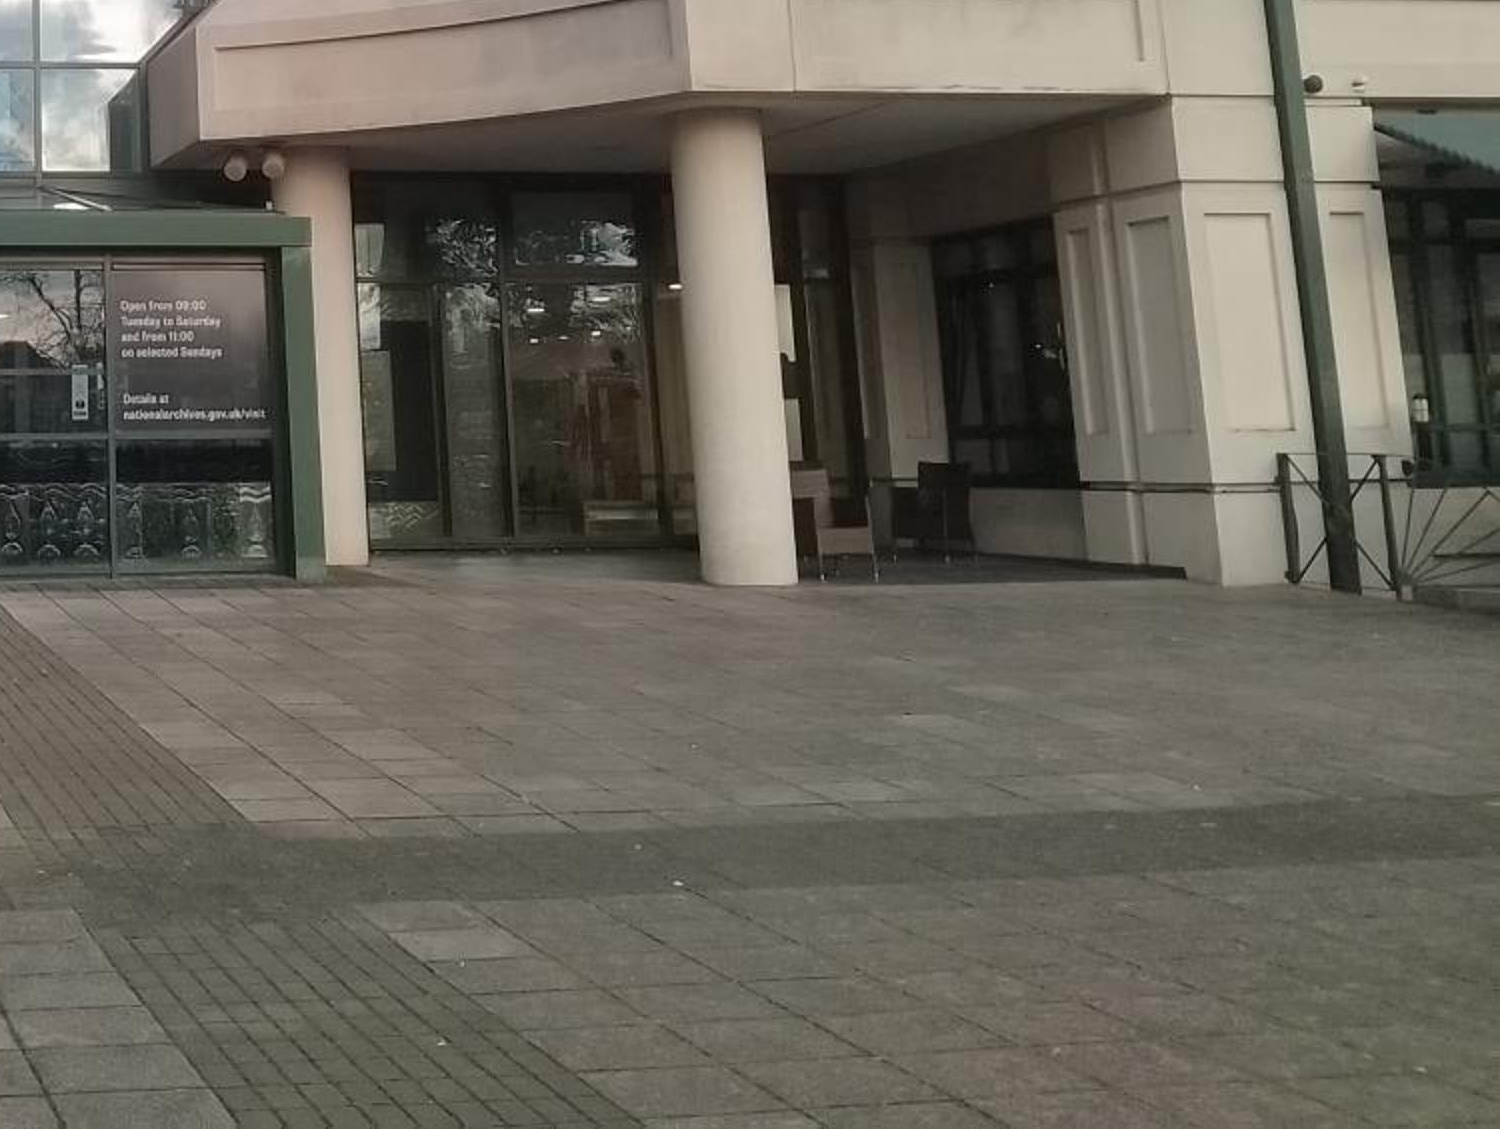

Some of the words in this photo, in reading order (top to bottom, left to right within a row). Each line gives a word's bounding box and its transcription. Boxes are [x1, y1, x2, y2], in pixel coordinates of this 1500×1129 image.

[120, 300, 147, 312] Open
[149, 300, 173, 311] from
[121, 316, 161, 328] Tuesday
[163, 317, 174, 327] to
[176, 316, 221, 329] Saturday
[121, 331, 140, 342] and
[142, 331, 167, 342] from
[169, 331, 194, 342] 11:00
[121, 348, 134, 358] on
[136, 346, 178, 358] selected
[180, 347, 223, 359] Sundays
[123, 393, 157, 405] Details
[159, 394, 169, 404] at
[123, 408, 266, 422] nationalarchives.gov.uk/visit
